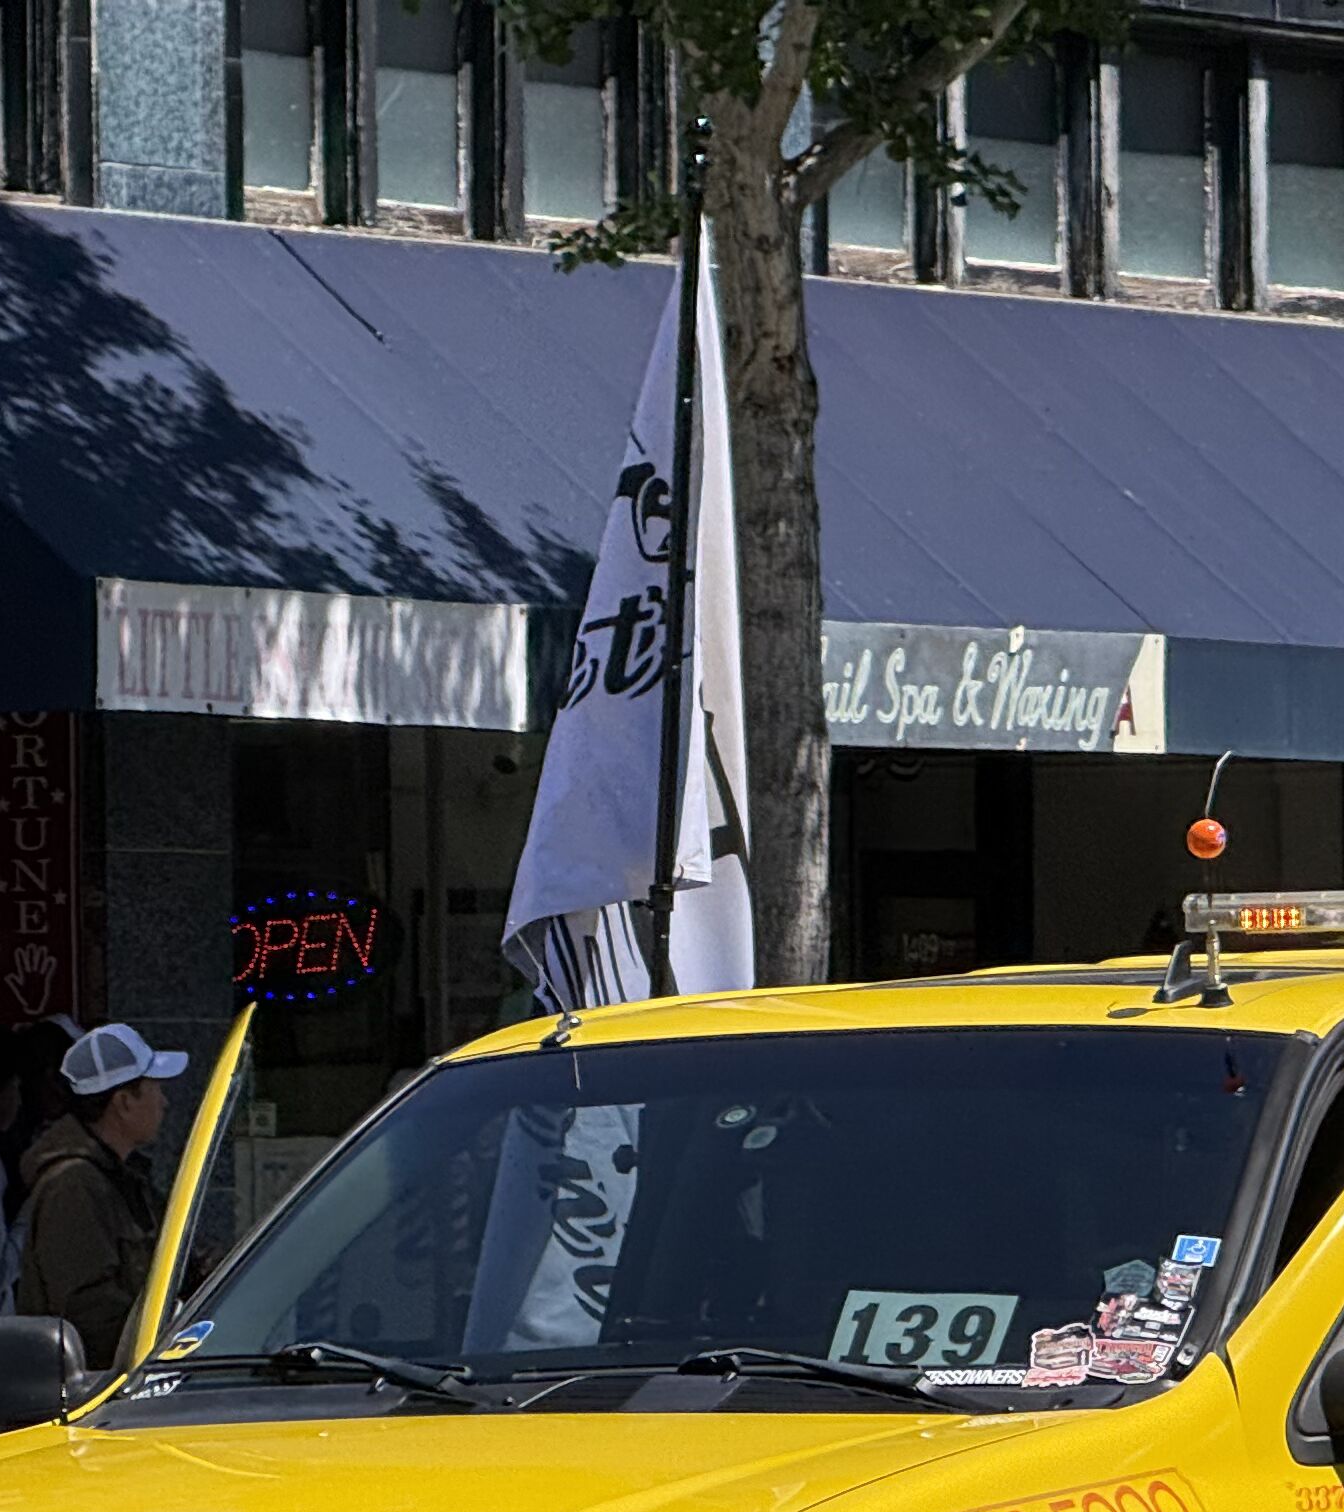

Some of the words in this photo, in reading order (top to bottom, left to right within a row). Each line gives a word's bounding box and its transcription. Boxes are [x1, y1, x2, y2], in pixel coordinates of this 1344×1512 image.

[822, 637, 869, 723] ail
[877, 648, 942, 741] Spa
[953, 641, 985, 727] &
[987, 648, 1109, 751] Waxing
[839, 1302, 997, 1366] 139
